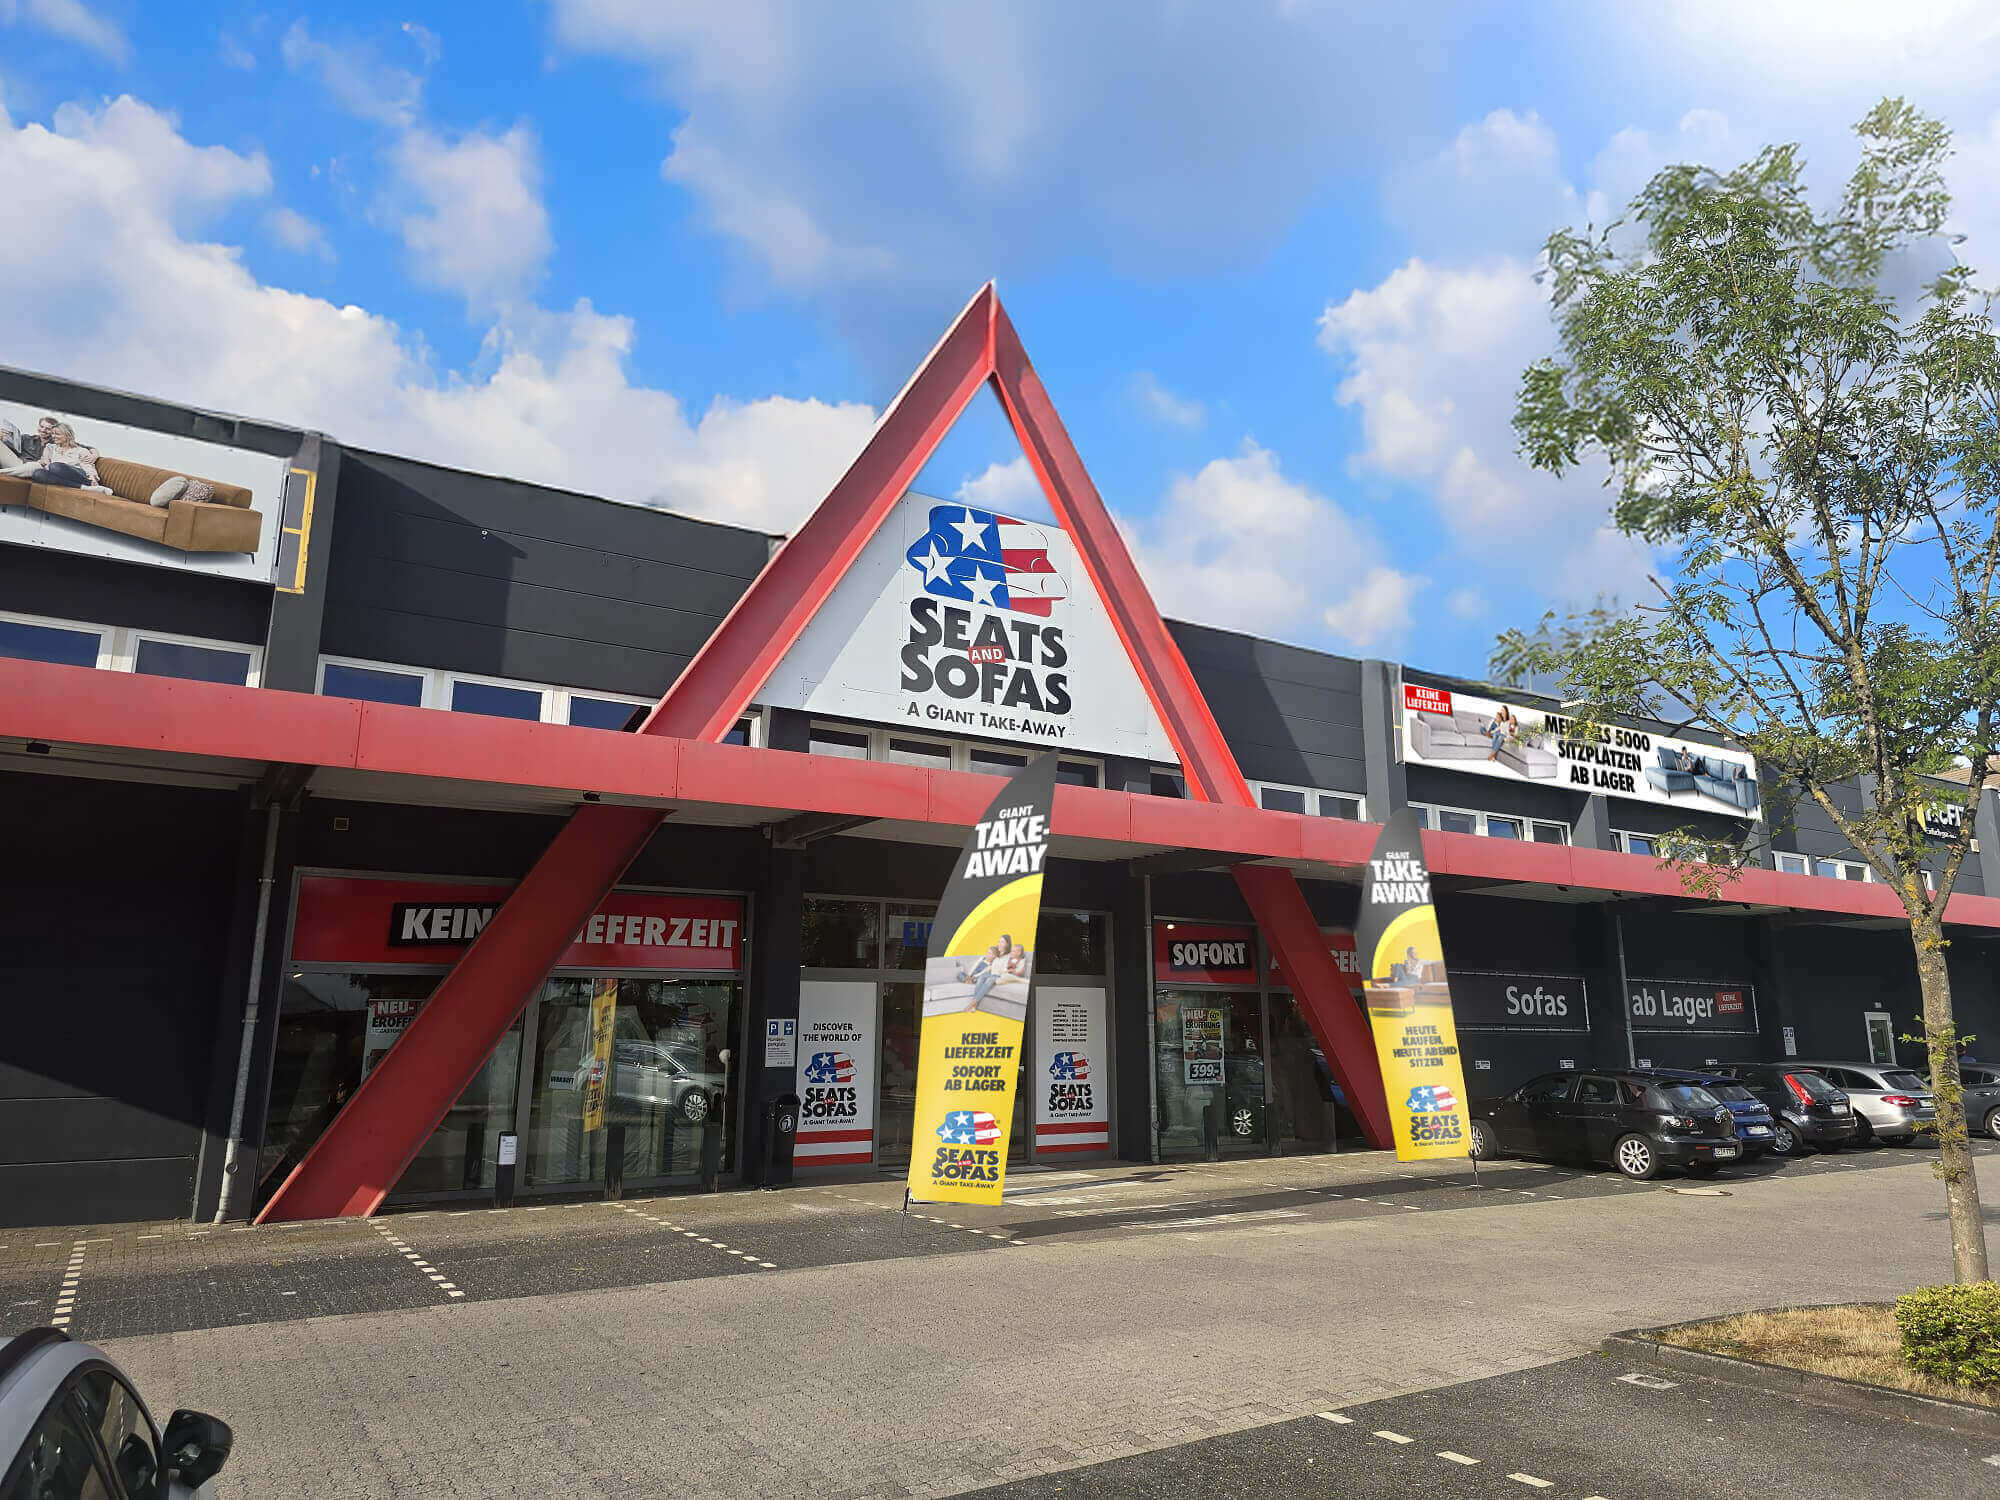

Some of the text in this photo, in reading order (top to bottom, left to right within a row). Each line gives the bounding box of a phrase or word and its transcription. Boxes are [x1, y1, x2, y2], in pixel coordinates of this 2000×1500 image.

[910, 597, 1068, 668] SEATS
[971, 647, 1003, 661] AND
[901, 642, 1071, 715] SOFAS
[1416, 688, 1439, 701] KEINE
[1407, 696, 1449, 712] LIEFERZEIT
[907, 701, 1066, 738] A GIANT TAKE-AWAY
[1615, 728, 1650, 752] 5000
[1570, 765, 1635, 793] AB LAGER
[999, 805, 1034, 819] GIANT
[975, 814, 1050, 850] TAKE-
[963, 844, 1048, 879] AWAY
[1370, 860, 1428, 881] TAKE-
[1371, 882, 1430, 904] AWAY
[401, 908, 498, 939] KEIN
[1172, 943, 1246, 966] SOFORT
[377, 1000, 415, 1014] NEU-
[1505, 986, 1568, 1016] Sofas
[1632, 988, 1714, 1025] ab Lager
[813, 1022, 853, 1031] DISCOVER
[1405, 1025, 1437, 1035] HEUTE
[803, 1033, 862, 1041] THE WORLD OF
[961, 1032, 999, 1045] KEINE
[944, 1046, 1014, 1059] LIEFERZEIT
[1393, 1046, 1457, 1058] HEUTE ABEND
[1410, 1058, 1444, 1068] SITZEN
[952, 1065, 1001, 1078] SOFORT
[944, 1079, 1006, 1092] AB LAGER
[1050, 1083, 1092, 1097] SEATS
[805, 1087, 857, 1102] SEATS
[802, 1102, 857, 1117] SOFAS
[1048, 1097, 1093, 1111] SOFAS
[1410, 1114, 1459, 1129] SEATS
[1410, 1127, 1462, 1141] SOFAS
[936, 1147, 999, 1165] SEATS
[931, 1163, 999, 1181] SOFAS
